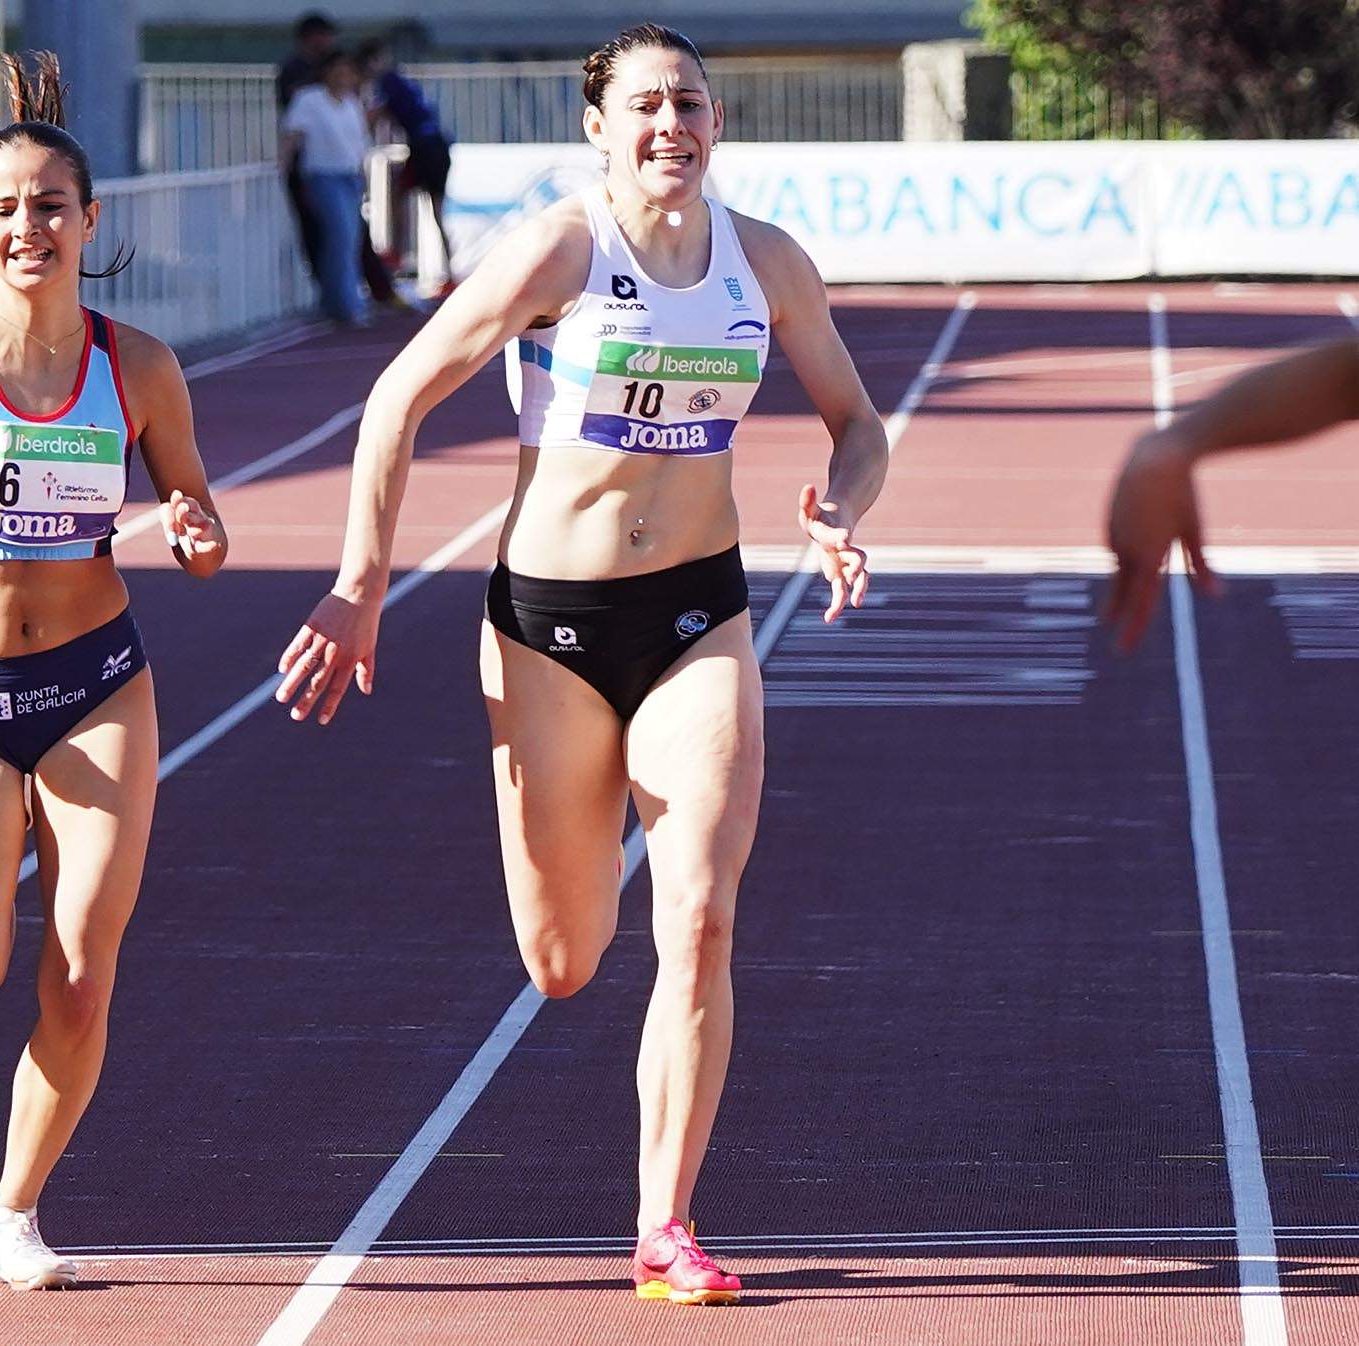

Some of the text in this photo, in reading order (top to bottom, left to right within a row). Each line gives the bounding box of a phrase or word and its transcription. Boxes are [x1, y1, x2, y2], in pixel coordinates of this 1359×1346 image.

[662, 356, 739, 376] Iberdrola
[623, 381, 665, 419] 10
[15, 434, 98, 456] Iberdrola
[620, 422, 709, 450] Joma
[16, 685, 60, 703] XUNTA
[16, 688, 87, 715] DE GALICIA
